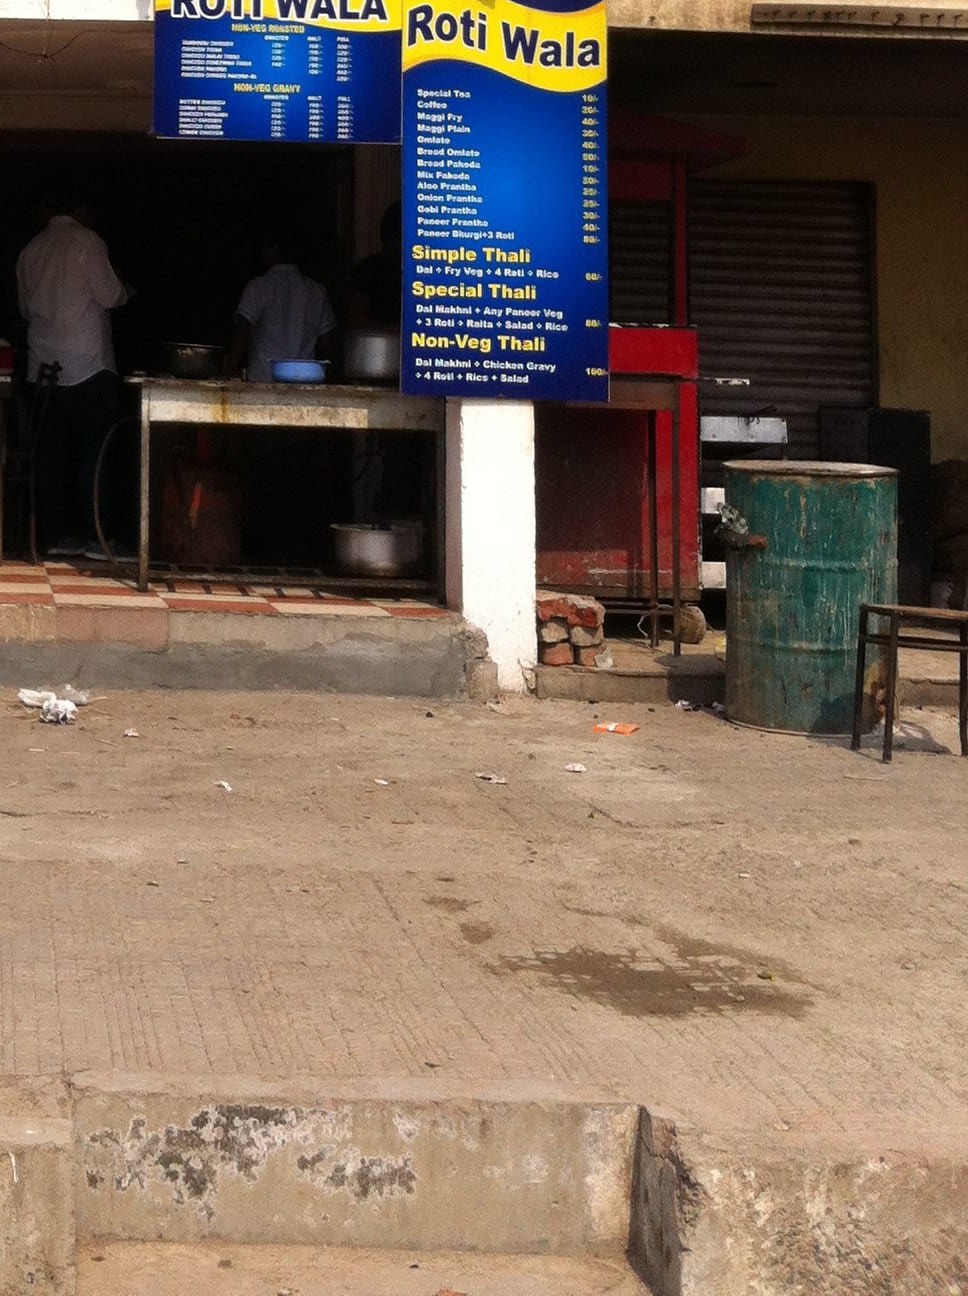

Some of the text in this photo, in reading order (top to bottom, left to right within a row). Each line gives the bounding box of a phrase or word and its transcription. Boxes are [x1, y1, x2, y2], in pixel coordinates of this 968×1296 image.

[407, 4, 600, 68] Roti Wala
[417, 89, 471, 98] Special Tea
[417, 100, 447, 109] Coffee
[417, 112, 463, 123] Maggi Fry
[417, 124, 471, 134] Maggi Plain
[417, 147, 445, 156] Bread
[417, 159, 445, 168] Bread
[417, 171, 434, 179] Mix
[417, 181, 438, 190] Aloo
[417, 193, 444, 202] Onion
[417, 205, 439, 214] Gobi
[417, 216, 450, 225] Paneer
[417, 228, 450, 237] Paneer
[496, 231, 515, 240] Roti
[412, 245, 531, 264] Simple Thali
[416, 265, 433, 274] Dal
[444, 267, 461, 277] Fry
[464, 267, 483, 278] Veg
[495, 268, 502, 276] 4
[504, 268, 525, 277] Roti
[536, 269, 559, 279] Rice
[412, 281, 537, 300] Special Thali
[416, 305, 433, 313] Dal
[435, 305, 472, 315] Makhni
[483, 307, 503, 317] Any
[505, 308, 541, 317] Paneer
[543, 309, 563, 320] Veg
[425, 318, 432, 326] 3
[434, 318, 455, 327] Roti
[466, 320, 494, 329] Raita
[505, 320, 534, 330] Salad
[545, 322, 569, 331] Rice
[411, 333, 546, 353] Non-Veg Thali
[415, 358, 432, 367] Dal
[435, 359, 472, 368] Makhni
[483, 360, 524, 370] Chicken
[527, 362, 556, 373] Gravy
[424, 372, 431, 380] 4
[434, 372, 455, 381] Roti
[466, 373, 489, 382] Rice
[500, 374, 529, 384] Salad
